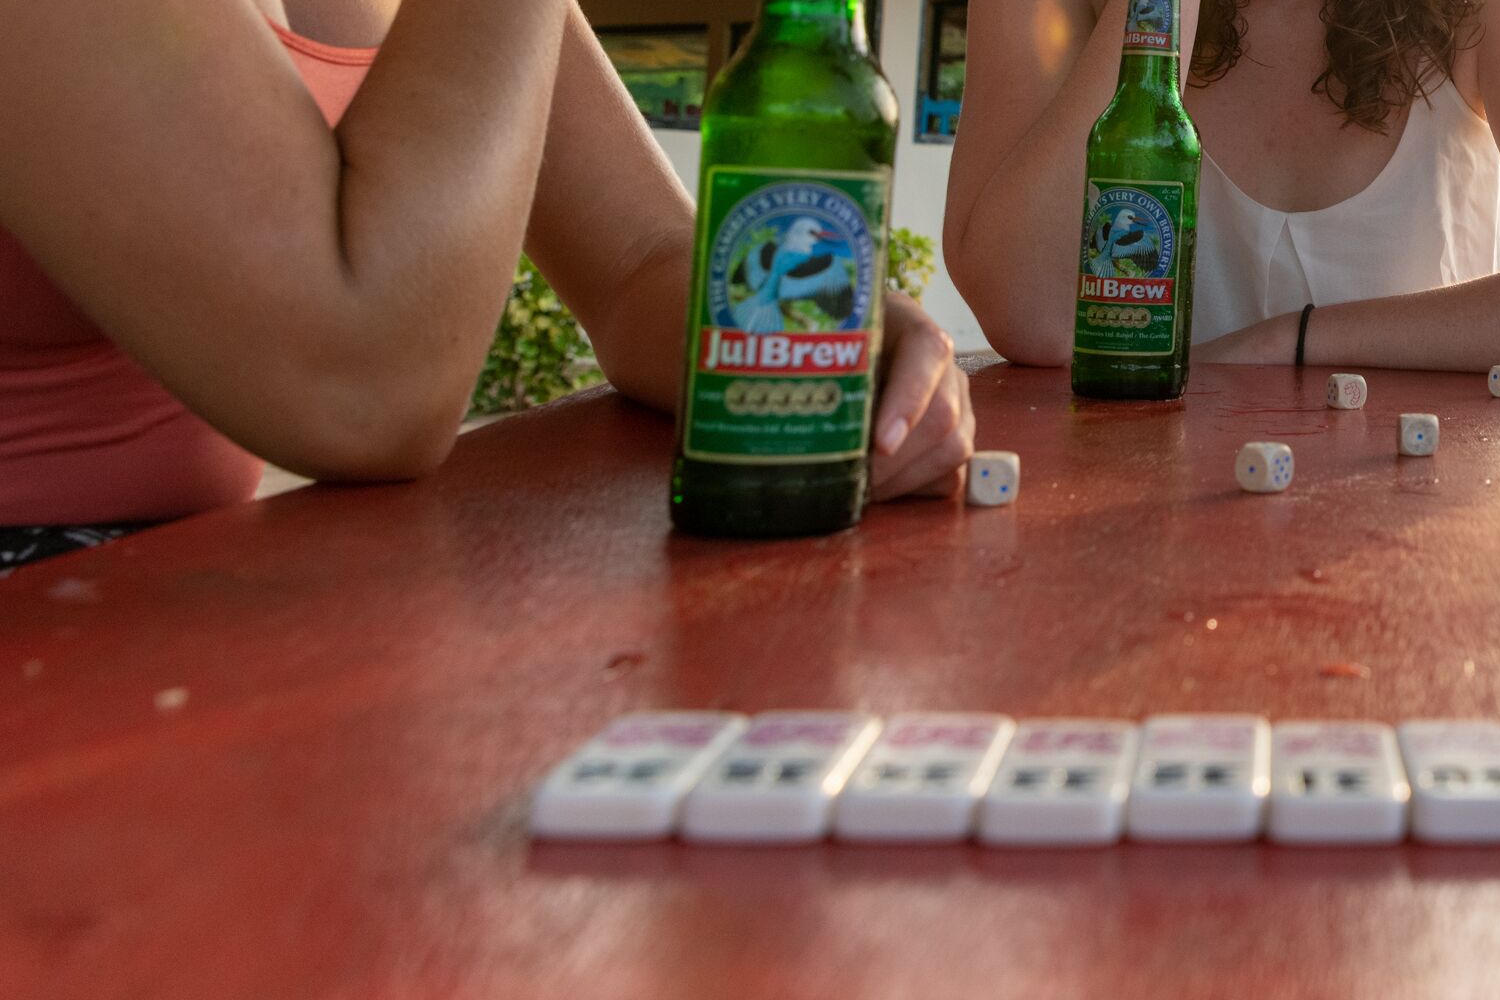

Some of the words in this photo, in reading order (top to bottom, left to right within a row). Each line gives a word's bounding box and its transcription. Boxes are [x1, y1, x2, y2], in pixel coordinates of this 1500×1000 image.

[772, 189, 823, 208] VERY
[1108, 191, 1136, 202] VERY
[1137, 196, 1163, 219] OWN
[1158, 218, 1172, 272] BREWERY
[1080, 276, 1166, 299] JulBrew
[707, 329, 862, 369] JulBrew
